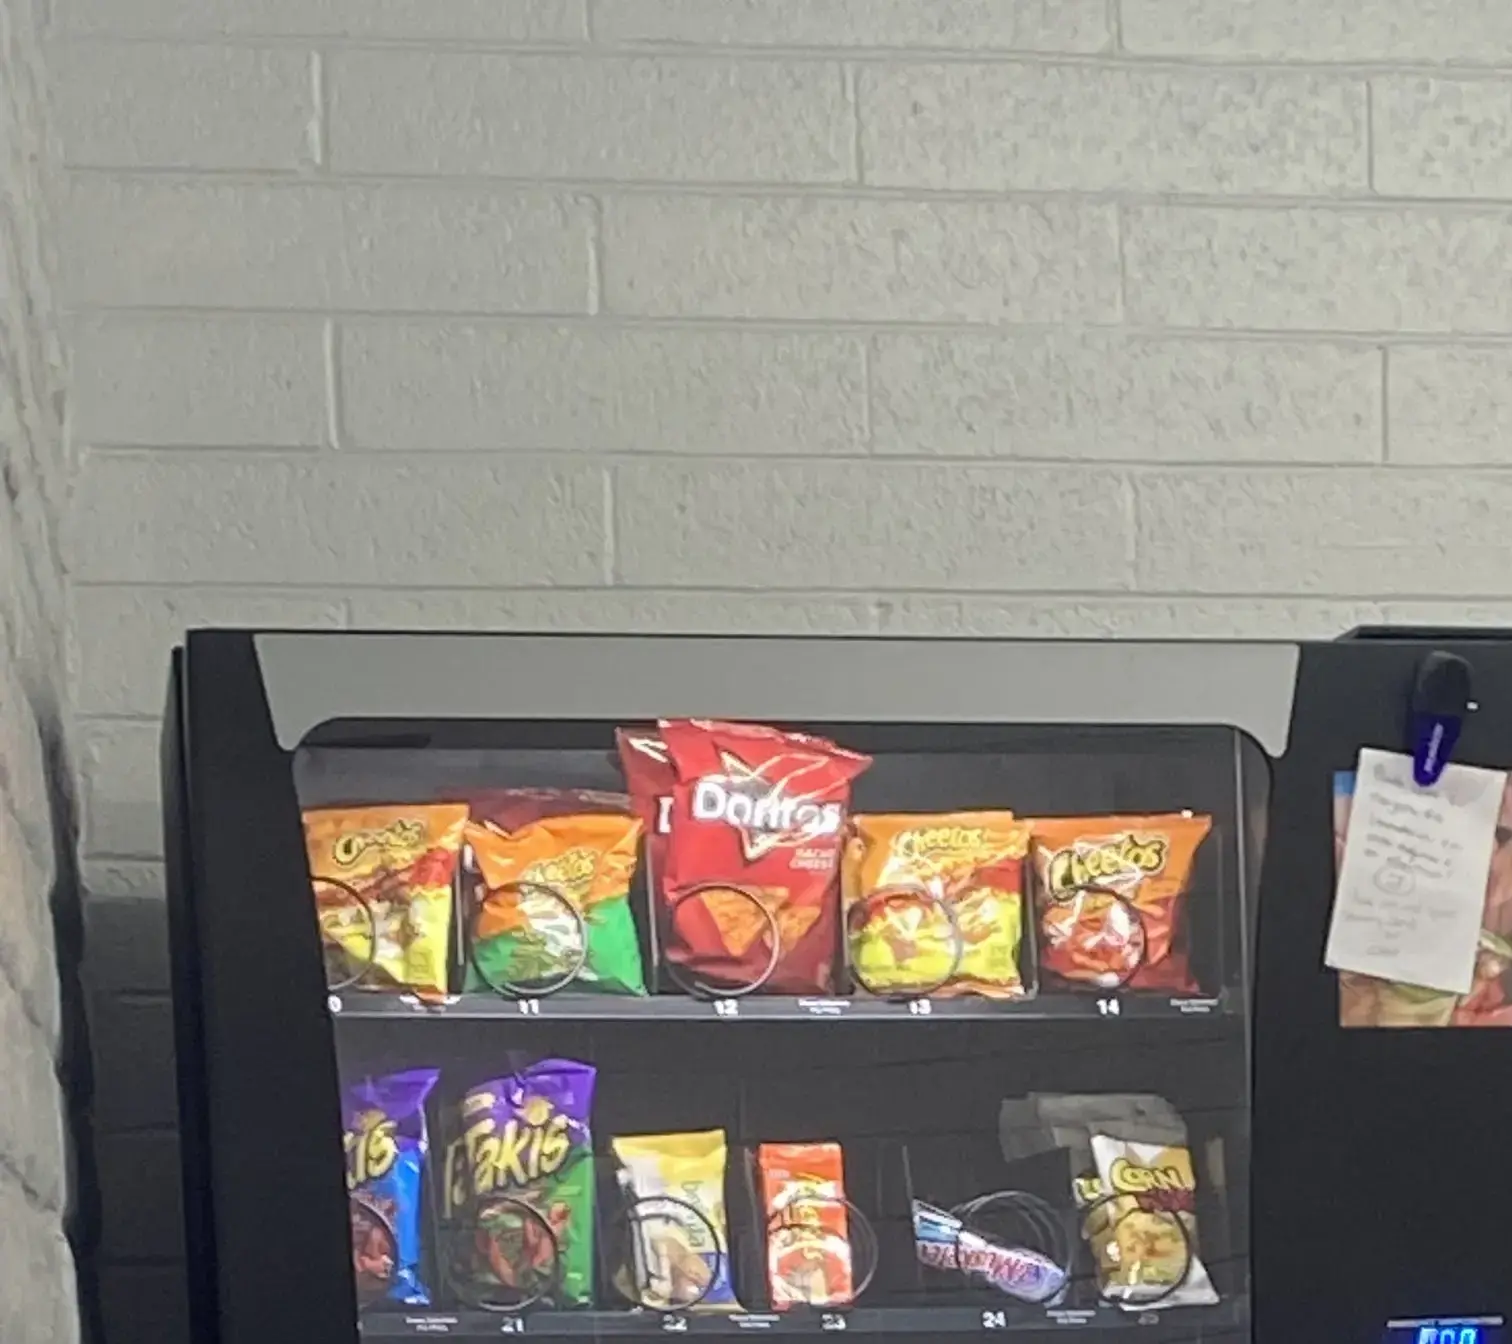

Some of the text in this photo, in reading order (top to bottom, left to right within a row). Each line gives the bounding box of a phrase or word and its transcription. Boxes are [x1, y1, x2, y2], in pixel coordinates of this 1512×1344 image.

[693, 781, 841, 833] Doritos
[1051, 834, 1166, 900] Cheetos
[519, 999, 539, 1015] 11
[714, 999, 738, 1015] 12
[909, 999, 932, 1015] 13
[1096, 999, 1120, 1015] 14
[465, 1115, 570, 1195] Takis
[501, 1317, 524, 1333] 21
[663, 1314, 688, 1331] 22
[822, 1314, 846, 1330] 23
[982, 1311, 1006, 1328] 24
